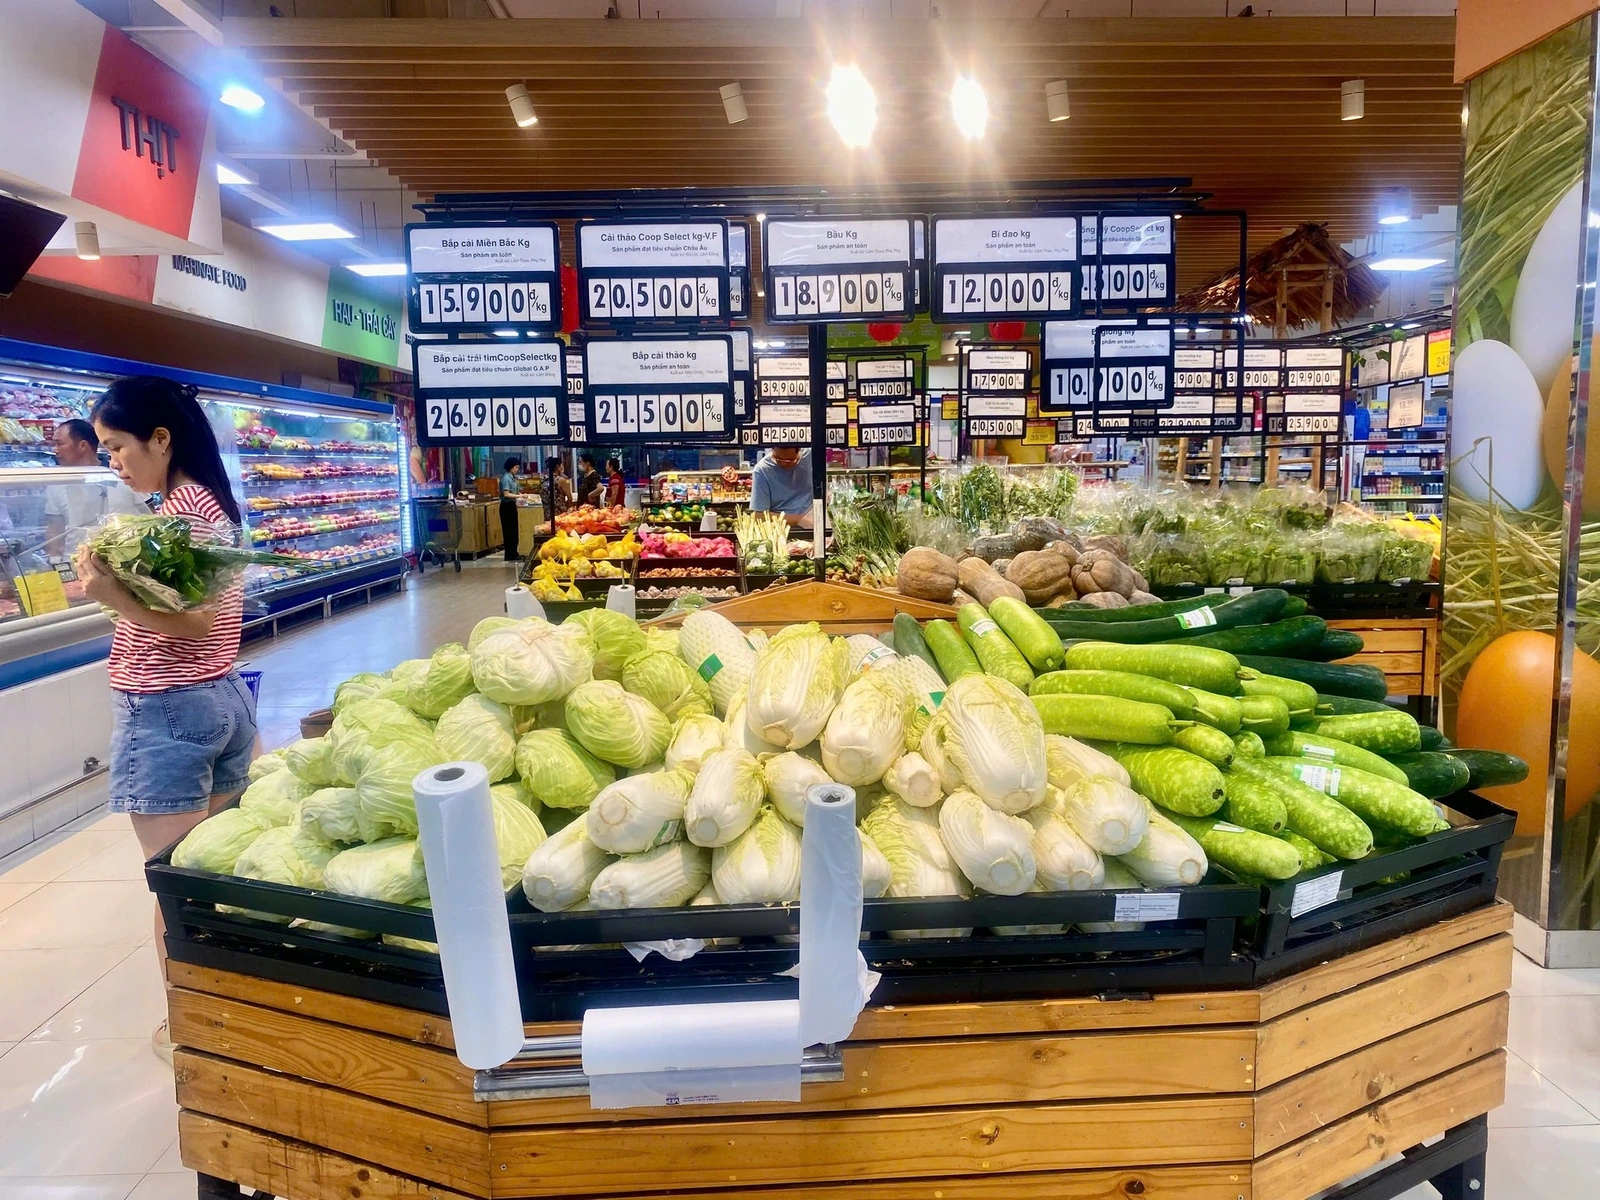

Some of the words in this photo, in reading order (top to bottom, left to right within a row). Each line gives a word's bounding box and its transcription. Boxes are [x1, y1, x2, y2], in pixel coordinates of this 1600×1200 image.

[111, 96, 180, 179] THỊT
[826, 230, 843, 239] Bầu
[846, 231, 857, 239] Kg
[991, 230, 1000, 238] Bí
[1021, 230, 1031, 239] kg
[1156, 225, 1165, 233] kg
[441, 238, 459, 249] Bắp
[461, 238, 473, 247] cải
[476, 238, 497, 247] Miền
[499, 238, 515, 247] Bắc
[518, 239, 530, 248] Kg
[600, 233, 615, 242] Cải
[617, 233, 636, 242] thảo
[638, 233, 661, 243] Coop
[663, 232, 690, 241] Select
[692, 232, 717, 242] kg-V.F
[172, 255, 222, 284] MARINATE
[222, 269, 247, 292] FOOD
[1150, 269, 1165, 290] đ/kg
[594, 283, 693, 309] 20.500
[699, 283, 716, 306] đ/kg
[781, 280, 878, 306] 18.900
[884, 278, 902, 301] đ/kg
[949, 278, 1045, 304] 12.000
[1052, 277, 1069, 300] đ/kg
[426, 287, 525, 314] 15.900
[529, 289, 547, 313] đ/kg
[333, 299, 353, 326] RAU
[359, 309, 380, 335] TRÁI
[381, 314, 396, 340] CÂY
[433, 354, 450, 364] Bắp
[452, 354, 465, 362] cải
[632, 352, 649, 361] Bắp
[651, 351, 664, 360] cải
[666, 351, 684, 359] thảo
[686, 351, 697, 360] kg
[974, 375, 1014, 386] 17.900
[1148, 370, 1163, 391] đ/kg
[1229, 373, 1268, 384] 3.900
[1290, 372, 1330, 384] 29.900
[763, 383, 804, 393] 39.900
[863, 383, 901, 394] 11.900
[430, 403, 531, 429] 26.900
[538, 403, 556, 426] đ/kg
[599, 400, 698, 426] 21.500
[705, 400, 722, 422] đ/kg
[972, 421, 1012, 432] 40.500
[1289, 418, 1328, 429] 25.900
[764, 427, 805, 439] 42.500
[864, 429, 903, 441] 21.500
